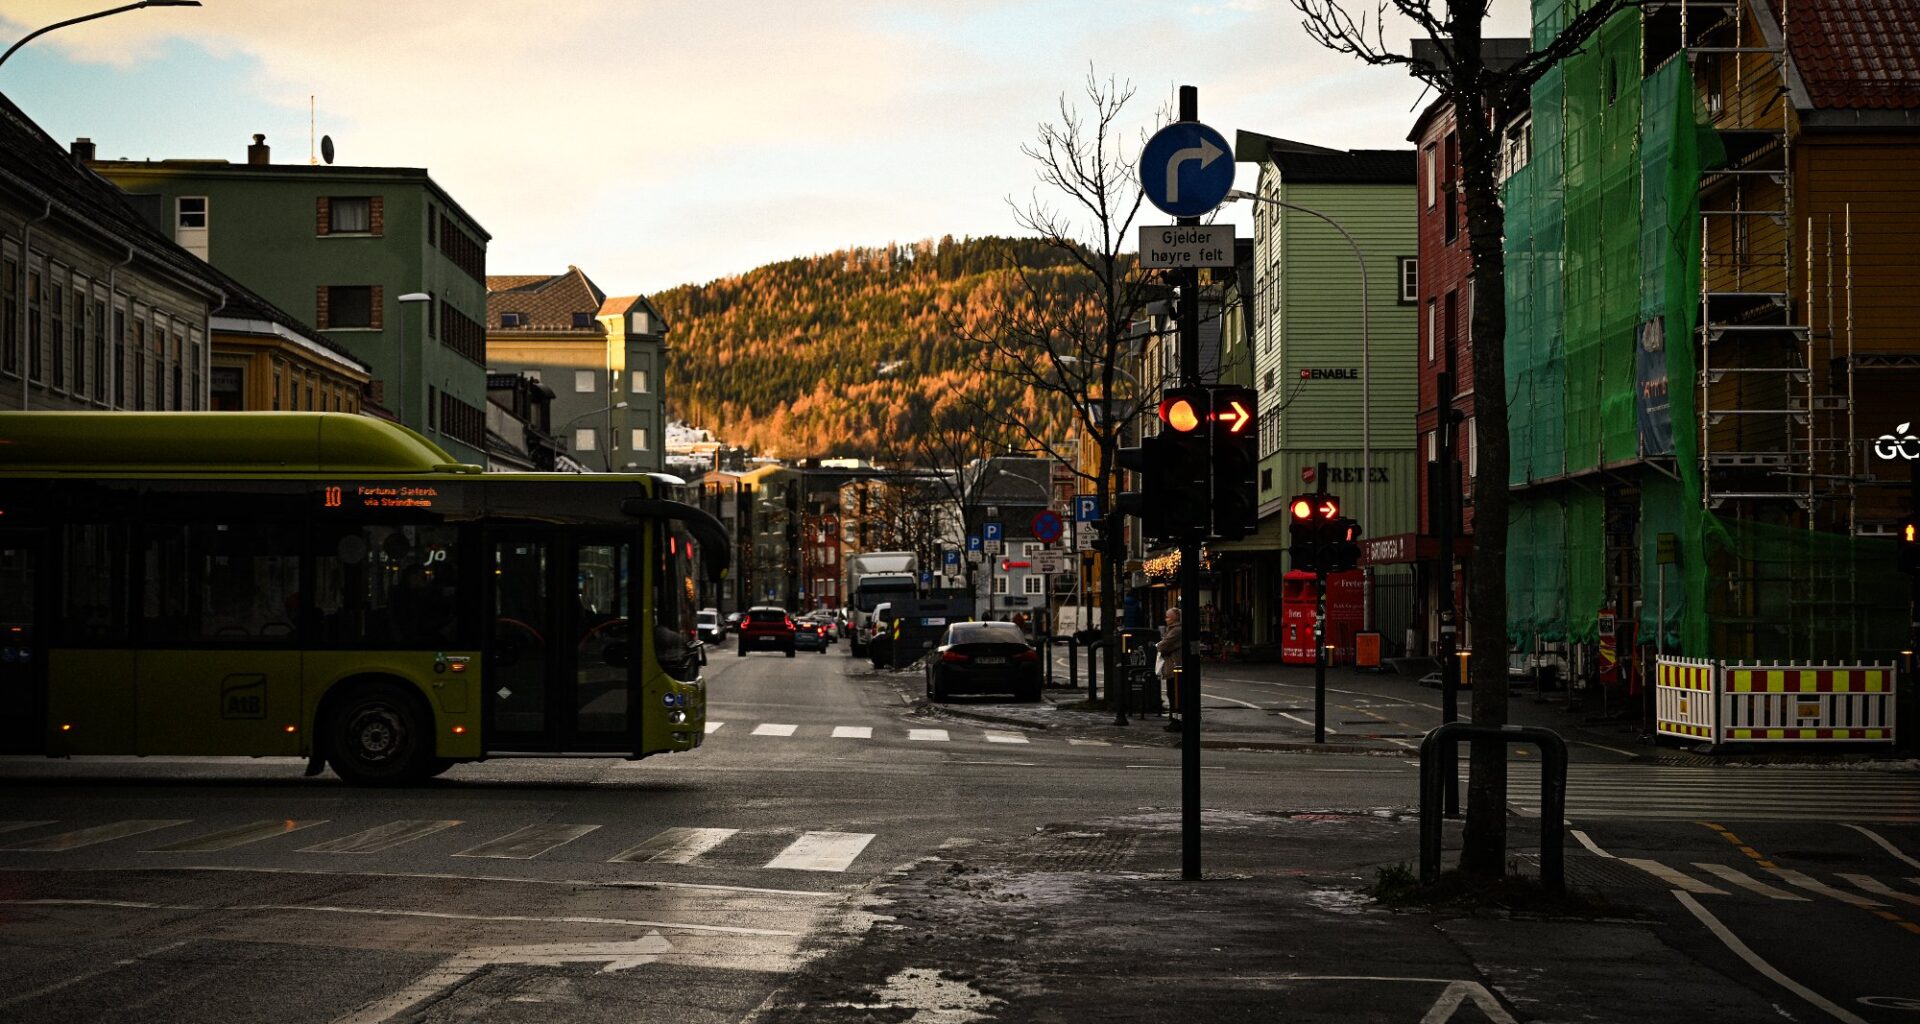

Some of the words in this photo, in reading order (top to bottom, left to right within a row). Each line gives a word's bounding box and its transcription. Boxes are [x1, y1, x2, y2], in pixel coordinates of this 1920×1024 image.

[1162, 231, 1211, 247] Gjelder
[1151, 249, 1190, 264] høyre
[1200, 248, 1223, 261] felt
[1311, 369, 1358, 379] ENABLE
[1326, 467, 1389, 482] RETEX
[324, 486, 342, 507] 10
[364, 498, 379, 506] via
[381, 497, 432, 507] Strindheim
[1081, 500, 1095, 518] P
[987, 525, 997, 539] P
[971, 538, 980, 549] P
[947, 552, 956, 563] P
